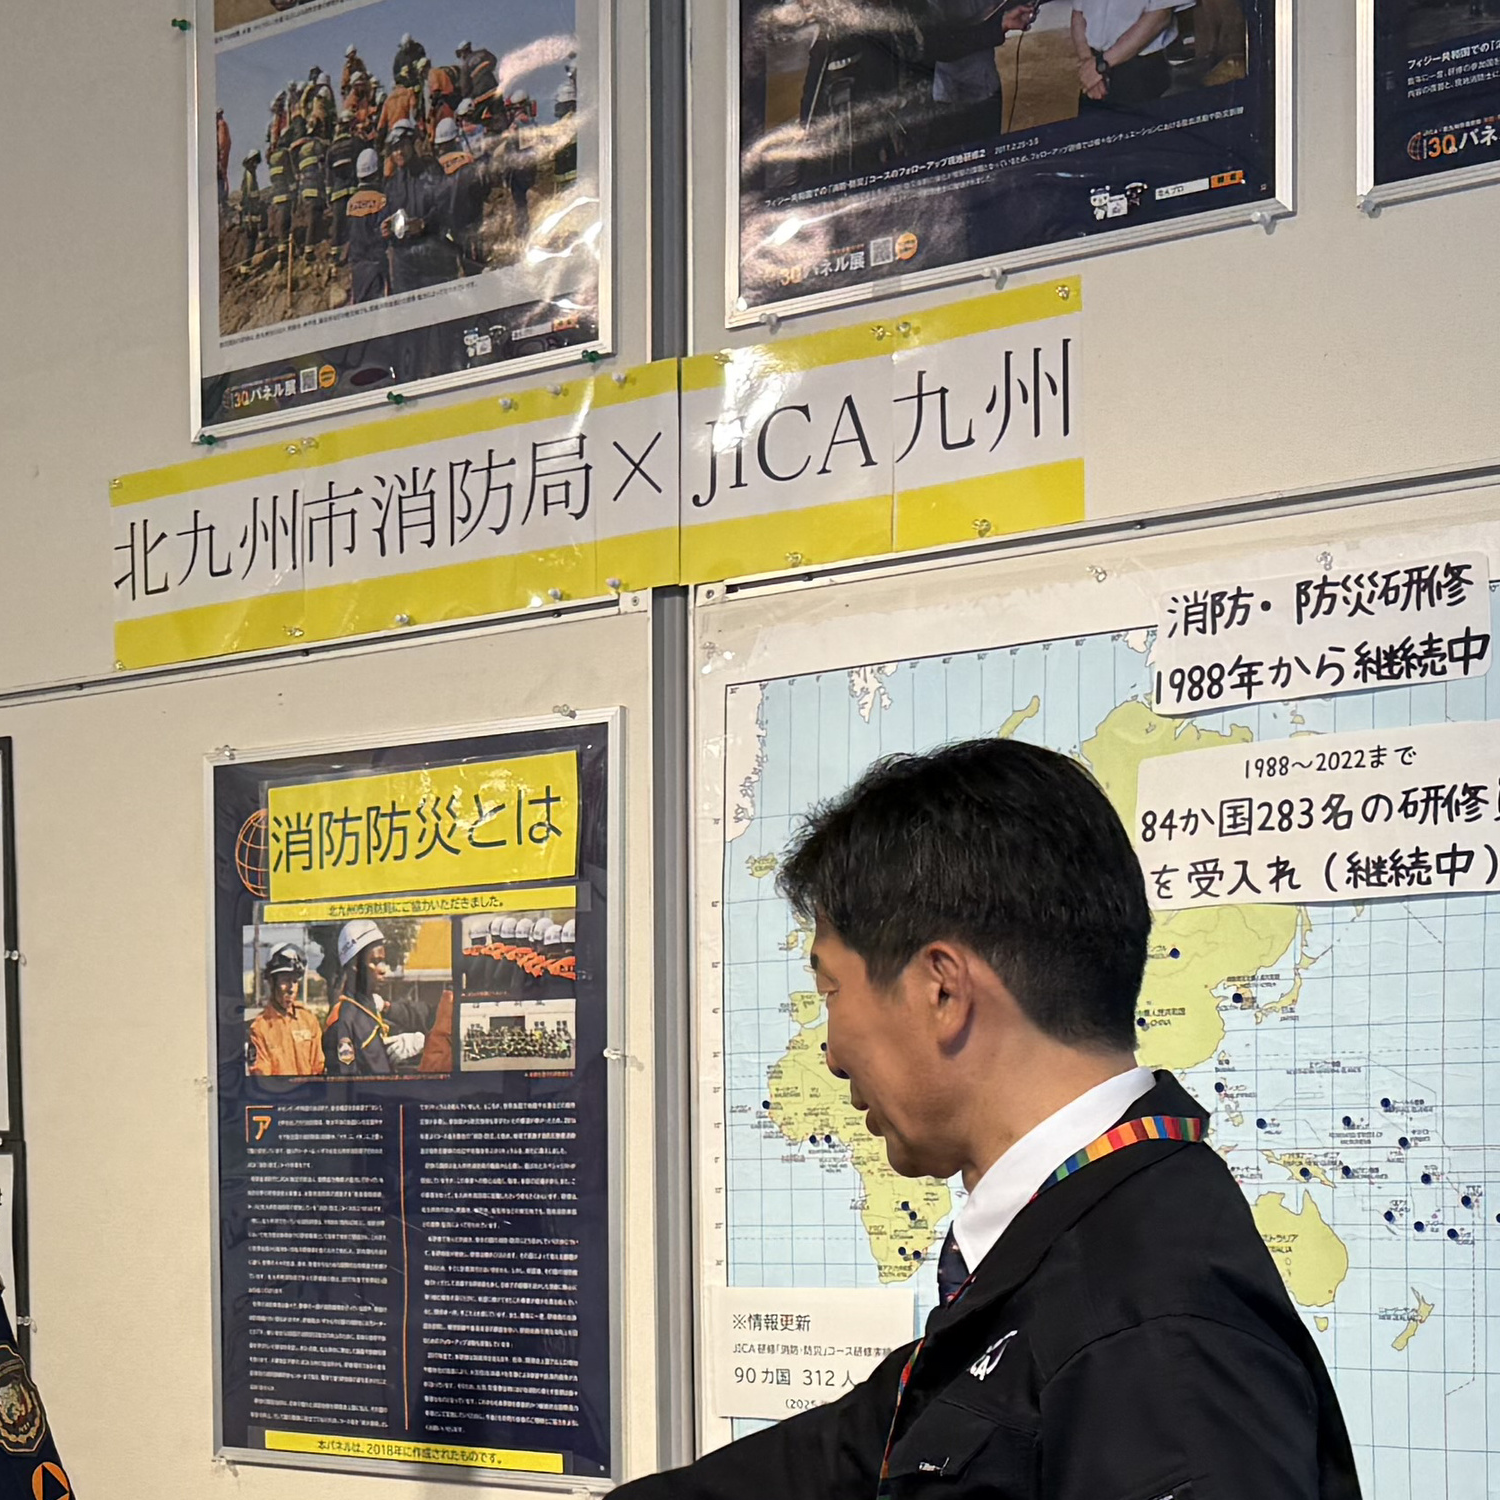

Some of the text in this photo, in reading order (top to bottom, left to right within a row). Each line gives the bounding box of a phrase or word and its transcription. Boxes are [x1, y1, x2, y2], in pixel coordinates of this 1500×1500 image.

[1155, 626, 1491, 704] 1988年から継続中
[271, 785, 564, 873] 消防防災とは
[1141, 778, 1500, 843] 84か国283名の研修
